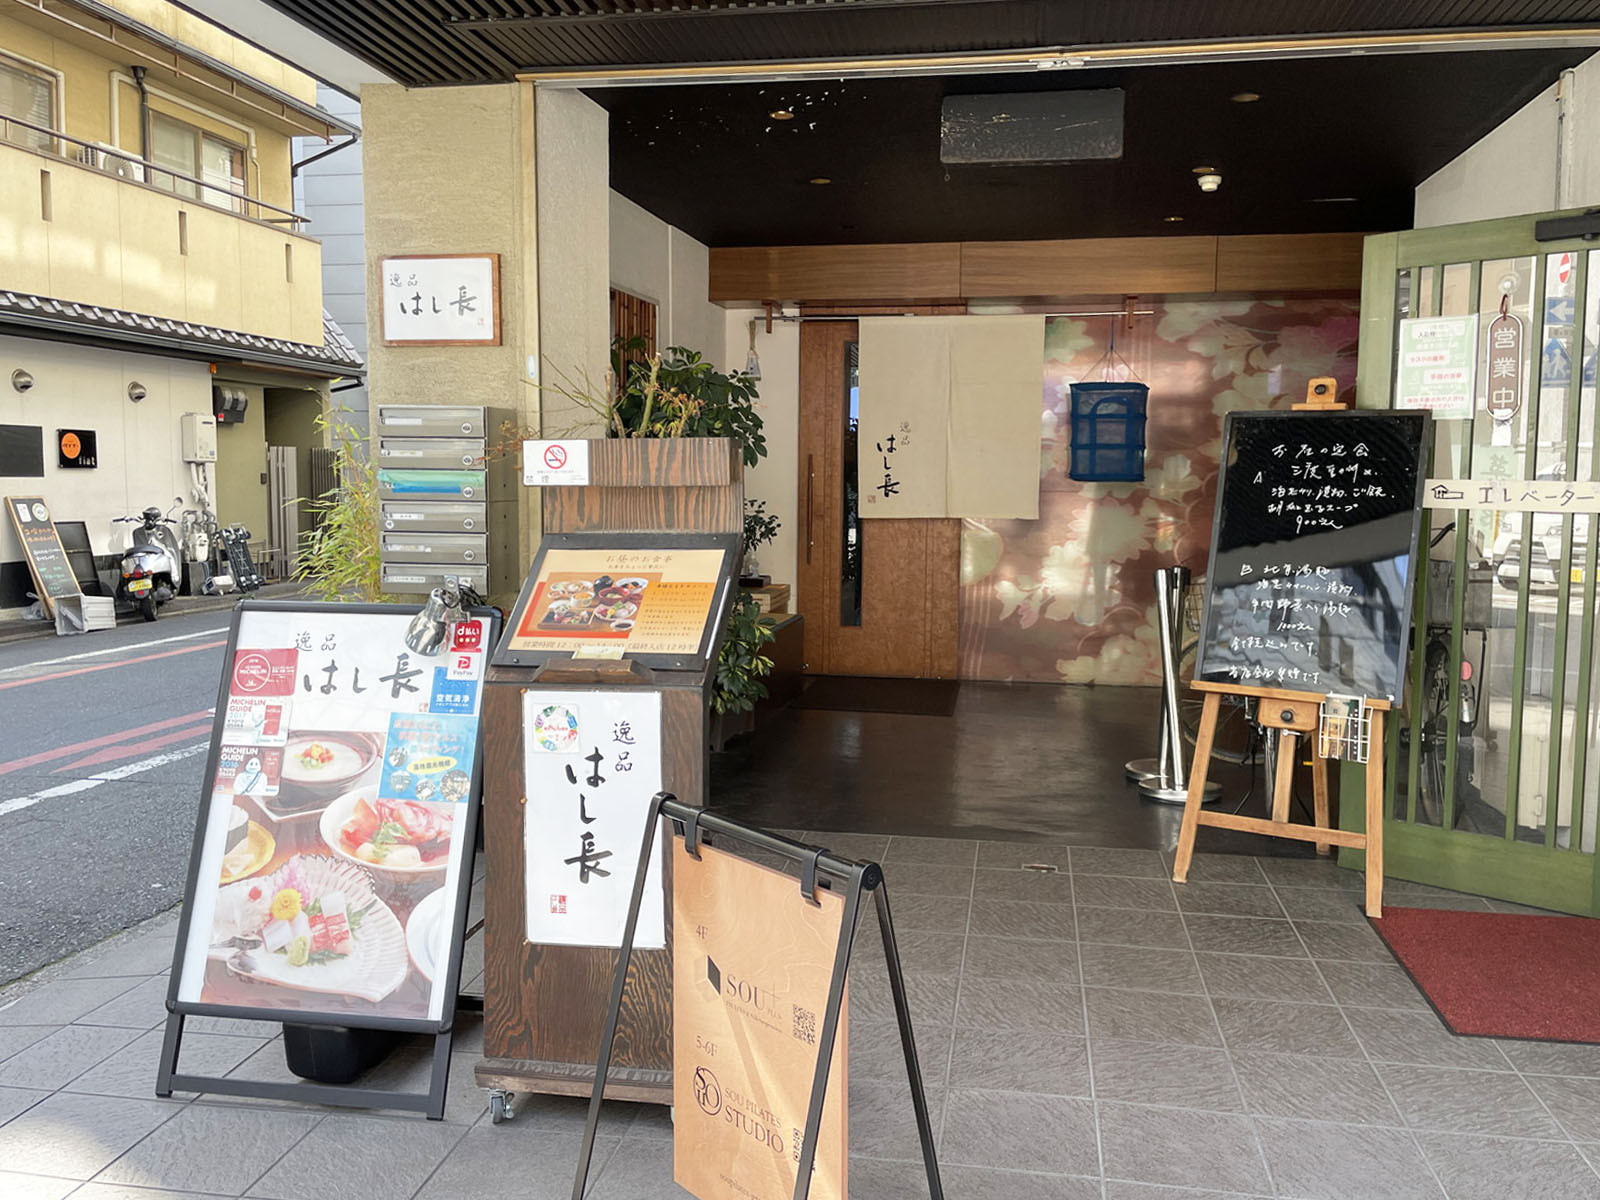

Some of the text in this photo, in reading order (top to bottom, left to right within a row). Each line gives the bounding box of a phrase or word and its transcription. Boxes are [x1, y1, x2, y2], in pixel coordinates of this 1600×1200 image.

[400, 285, 477, 316] はし長
[1493, 327, 1516, 408] 営業中
[876, 434, 900, 497] はし長
[1253, 471, 1263, 484] A
[1479, 486, 1595, 507] エレベーター
[1240, 563, 1253, 576] B
[457, 625, 480, 636] d払い
[295, 632, 336, 652] 逸品
[303, 652, 423, 699] はし長
[230, 698, 266, 706] MICHELIN
[435, 694, 470, 703] 空気清浄
[229, 705, 252, 713] GUIDE
[221, 746, 259, 755] MICHELIN
[613, 720, 636, 772] 逸品
[220, 753, 245, 762] GUIDE
[564, 746, 613, 884] はし長
[695, 924, 708, 940] 4F
[695, 1035, 718, 1057] 5-6F
[724, 1087, 782, 1129] SOU PILATES
[725, 1105, 784, 1154] STUDIO
